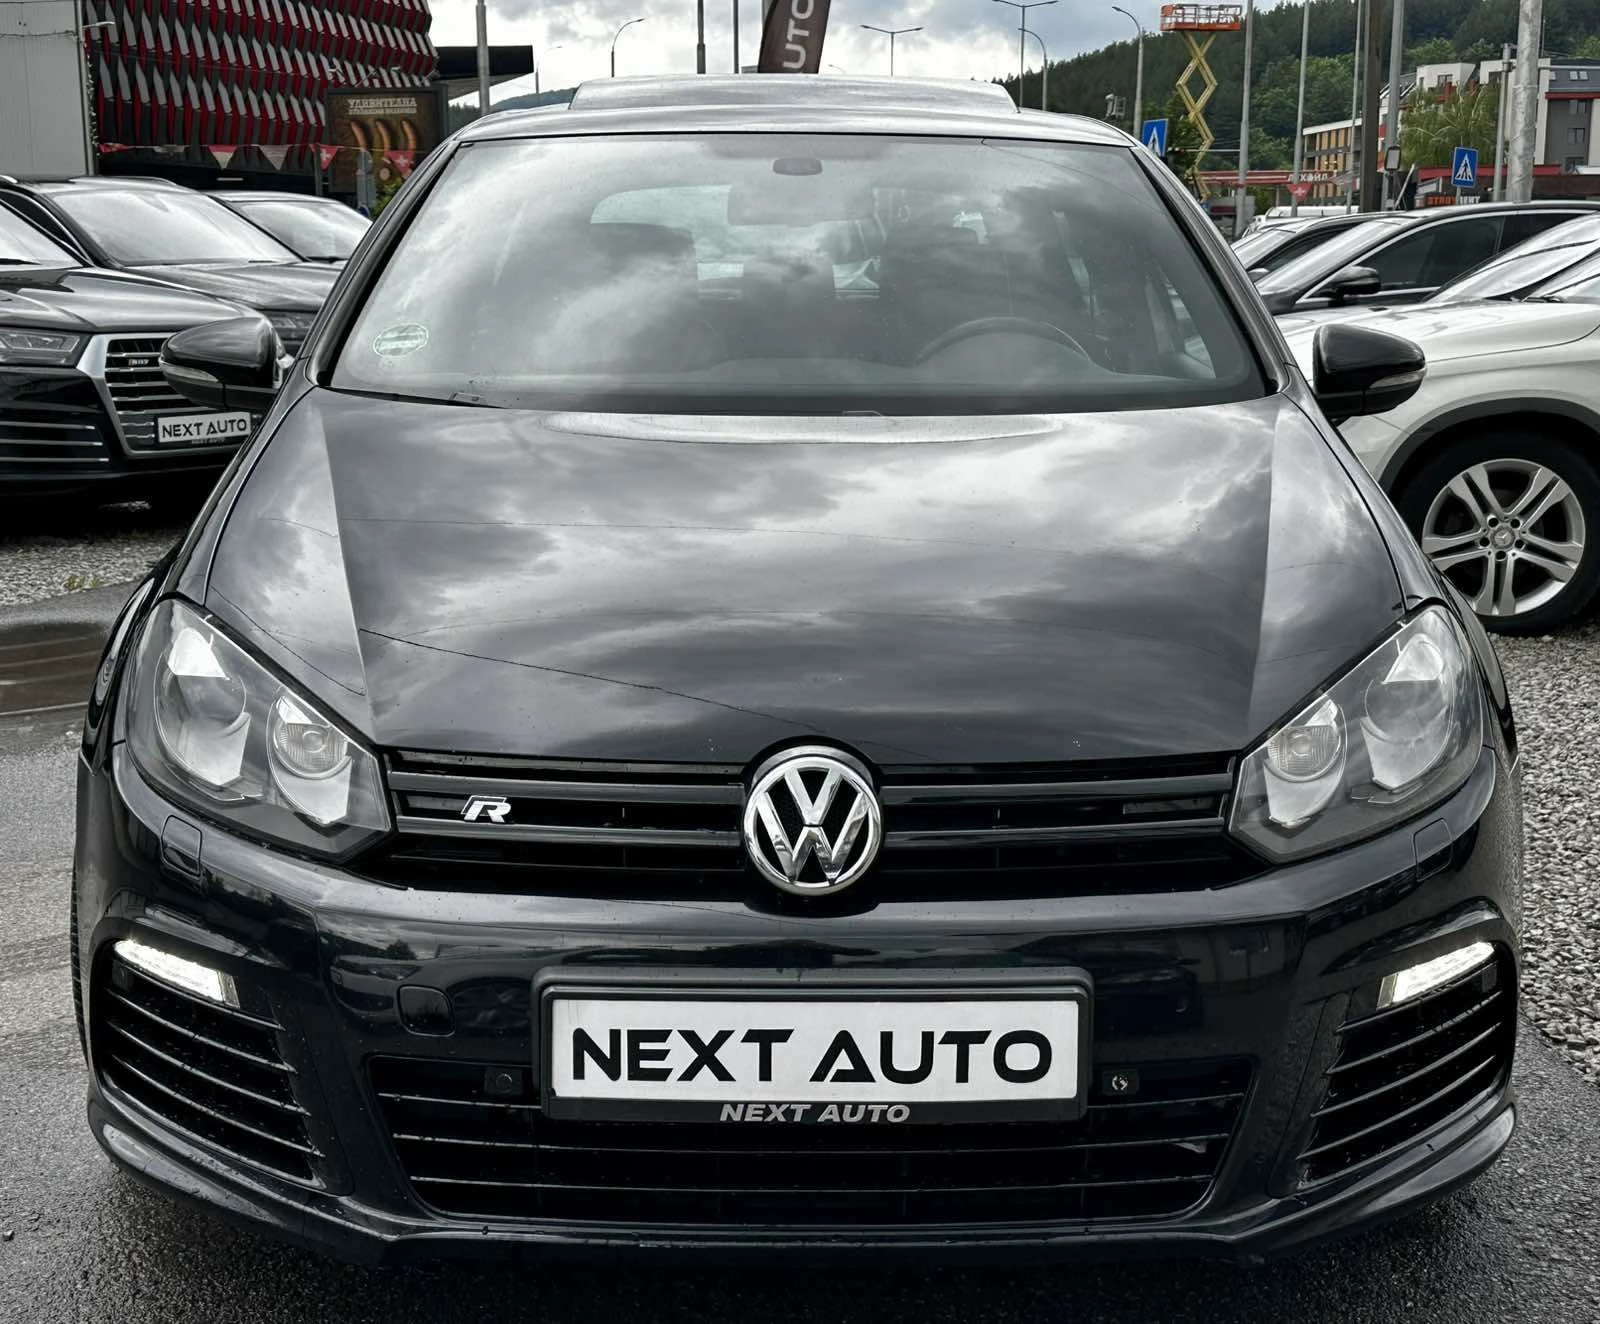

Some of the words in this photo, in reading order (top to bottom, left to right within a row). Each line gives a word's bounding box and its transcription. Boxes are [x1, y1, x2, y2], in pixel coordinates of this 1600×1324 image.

[782, 0, 815, 73] UTO
[162, 422, 203, 438] NEXT
[206, 418, 247, 435] AUTO
[461, 794, 512, 824] R
[572, 1027, 795, 1083] NEXT
[809, 1028, 1053, 1085] AUTO
[719, 1103, 811, 1123] NEXT
[817, 1103, 911, 1123] AUTO
